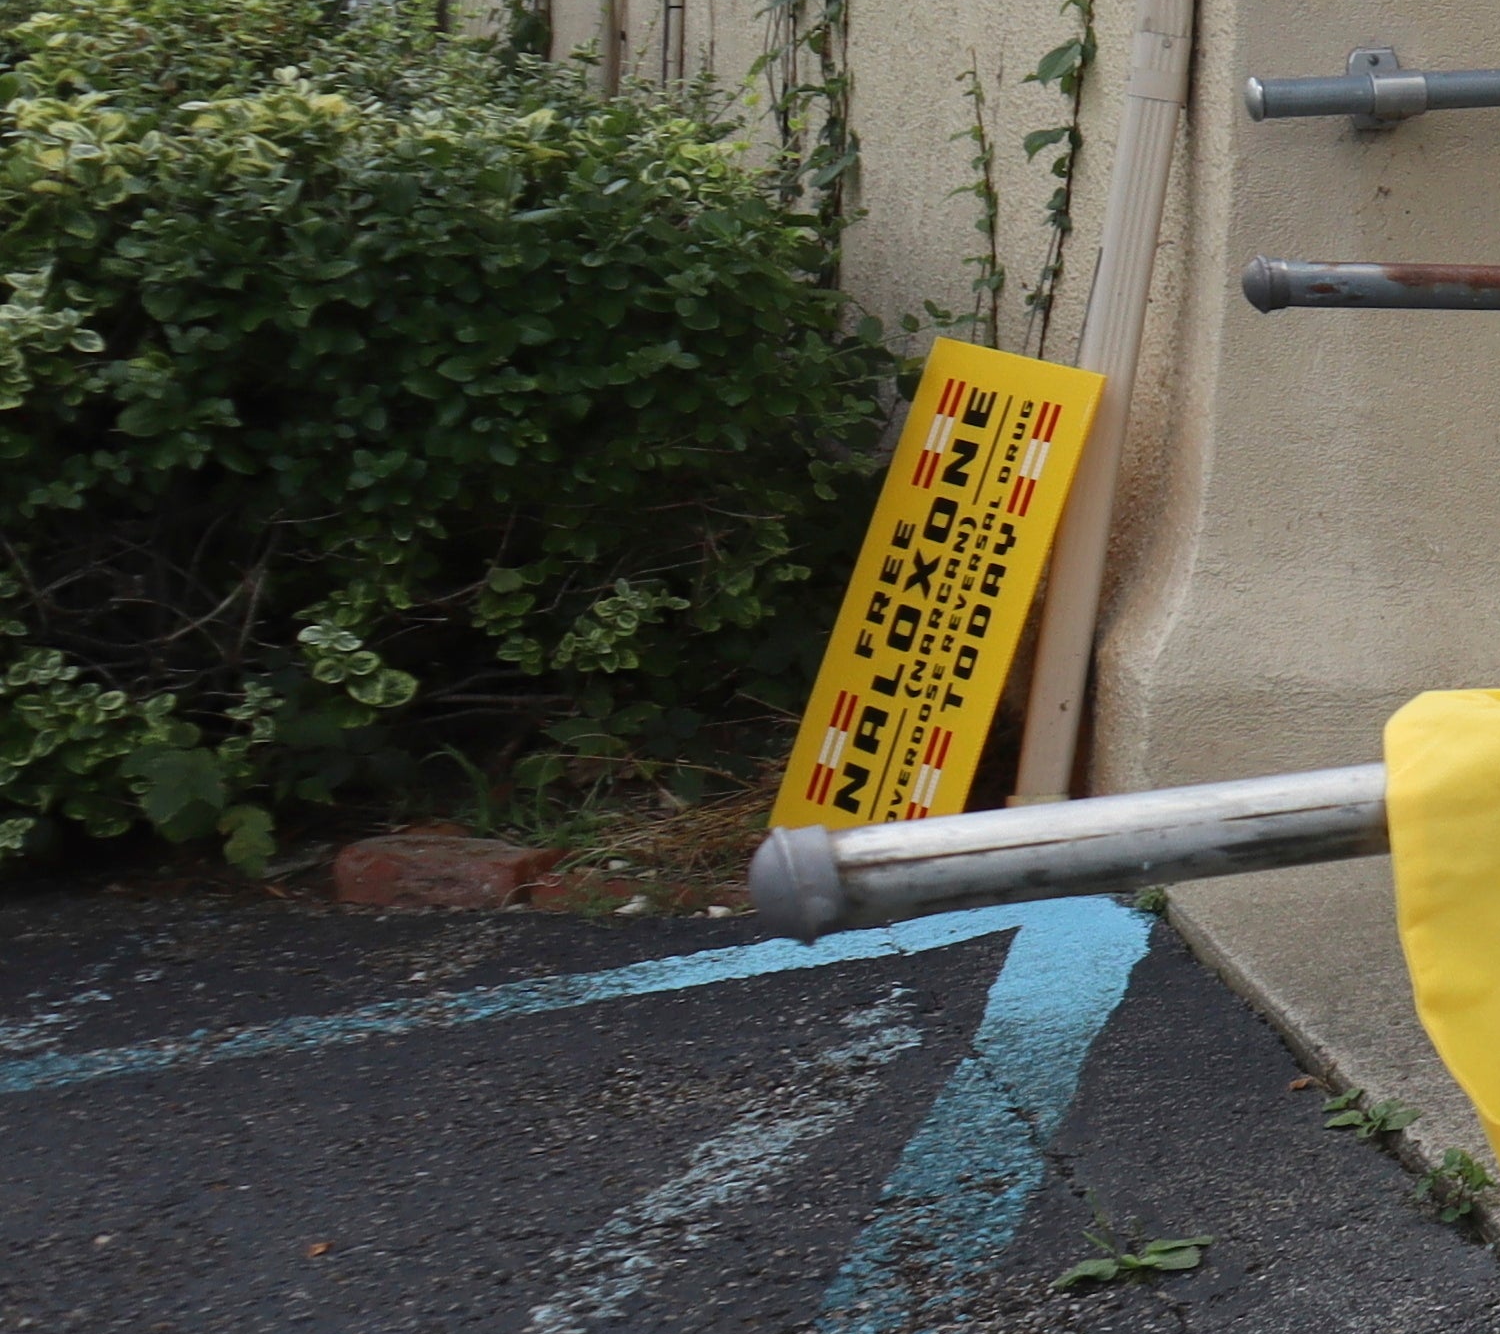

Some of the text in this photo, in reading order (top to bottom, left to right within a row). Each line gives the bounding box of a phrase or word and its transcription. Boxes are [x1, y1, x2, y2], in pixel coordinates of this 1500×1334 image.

[832, 386, 998, 816] NALOXONE
[853, 518, 916, 659] FREE
[885, 399, 1034, 823] OVERDOSE REVERSAL DRUG
[904, 515, 977, 699] (NARCAN)
[940, 522, 1016, 713] TODAY
